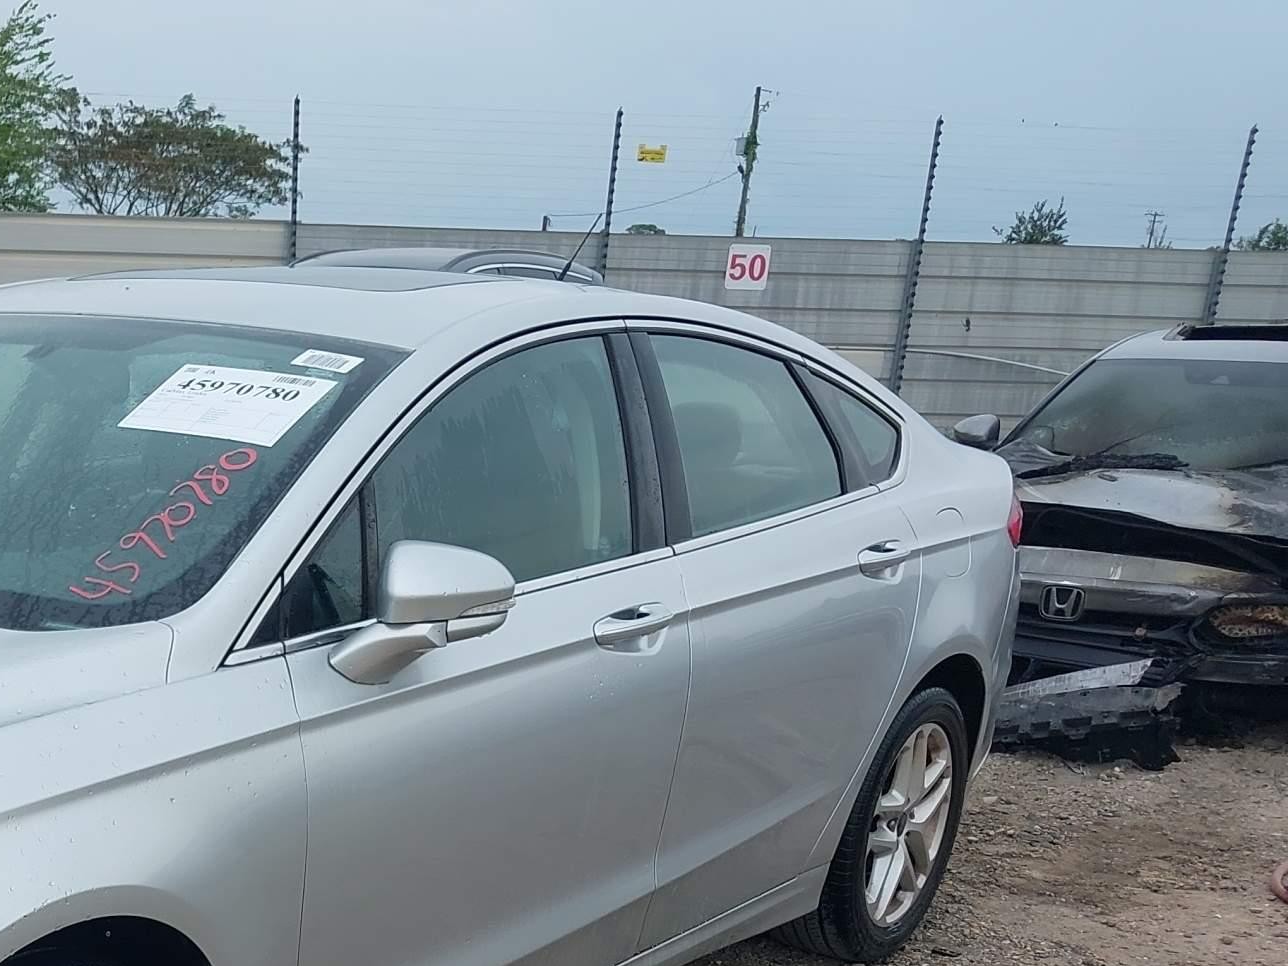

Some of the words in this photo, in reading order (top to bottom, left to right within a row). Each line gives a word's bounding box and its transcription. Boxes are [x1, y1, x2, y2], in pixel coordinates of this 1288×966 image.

[728, 253, 767, 282] 50
[177, 377, 302, 402] 45970780
[68, 447, 258, 600] 45970780
